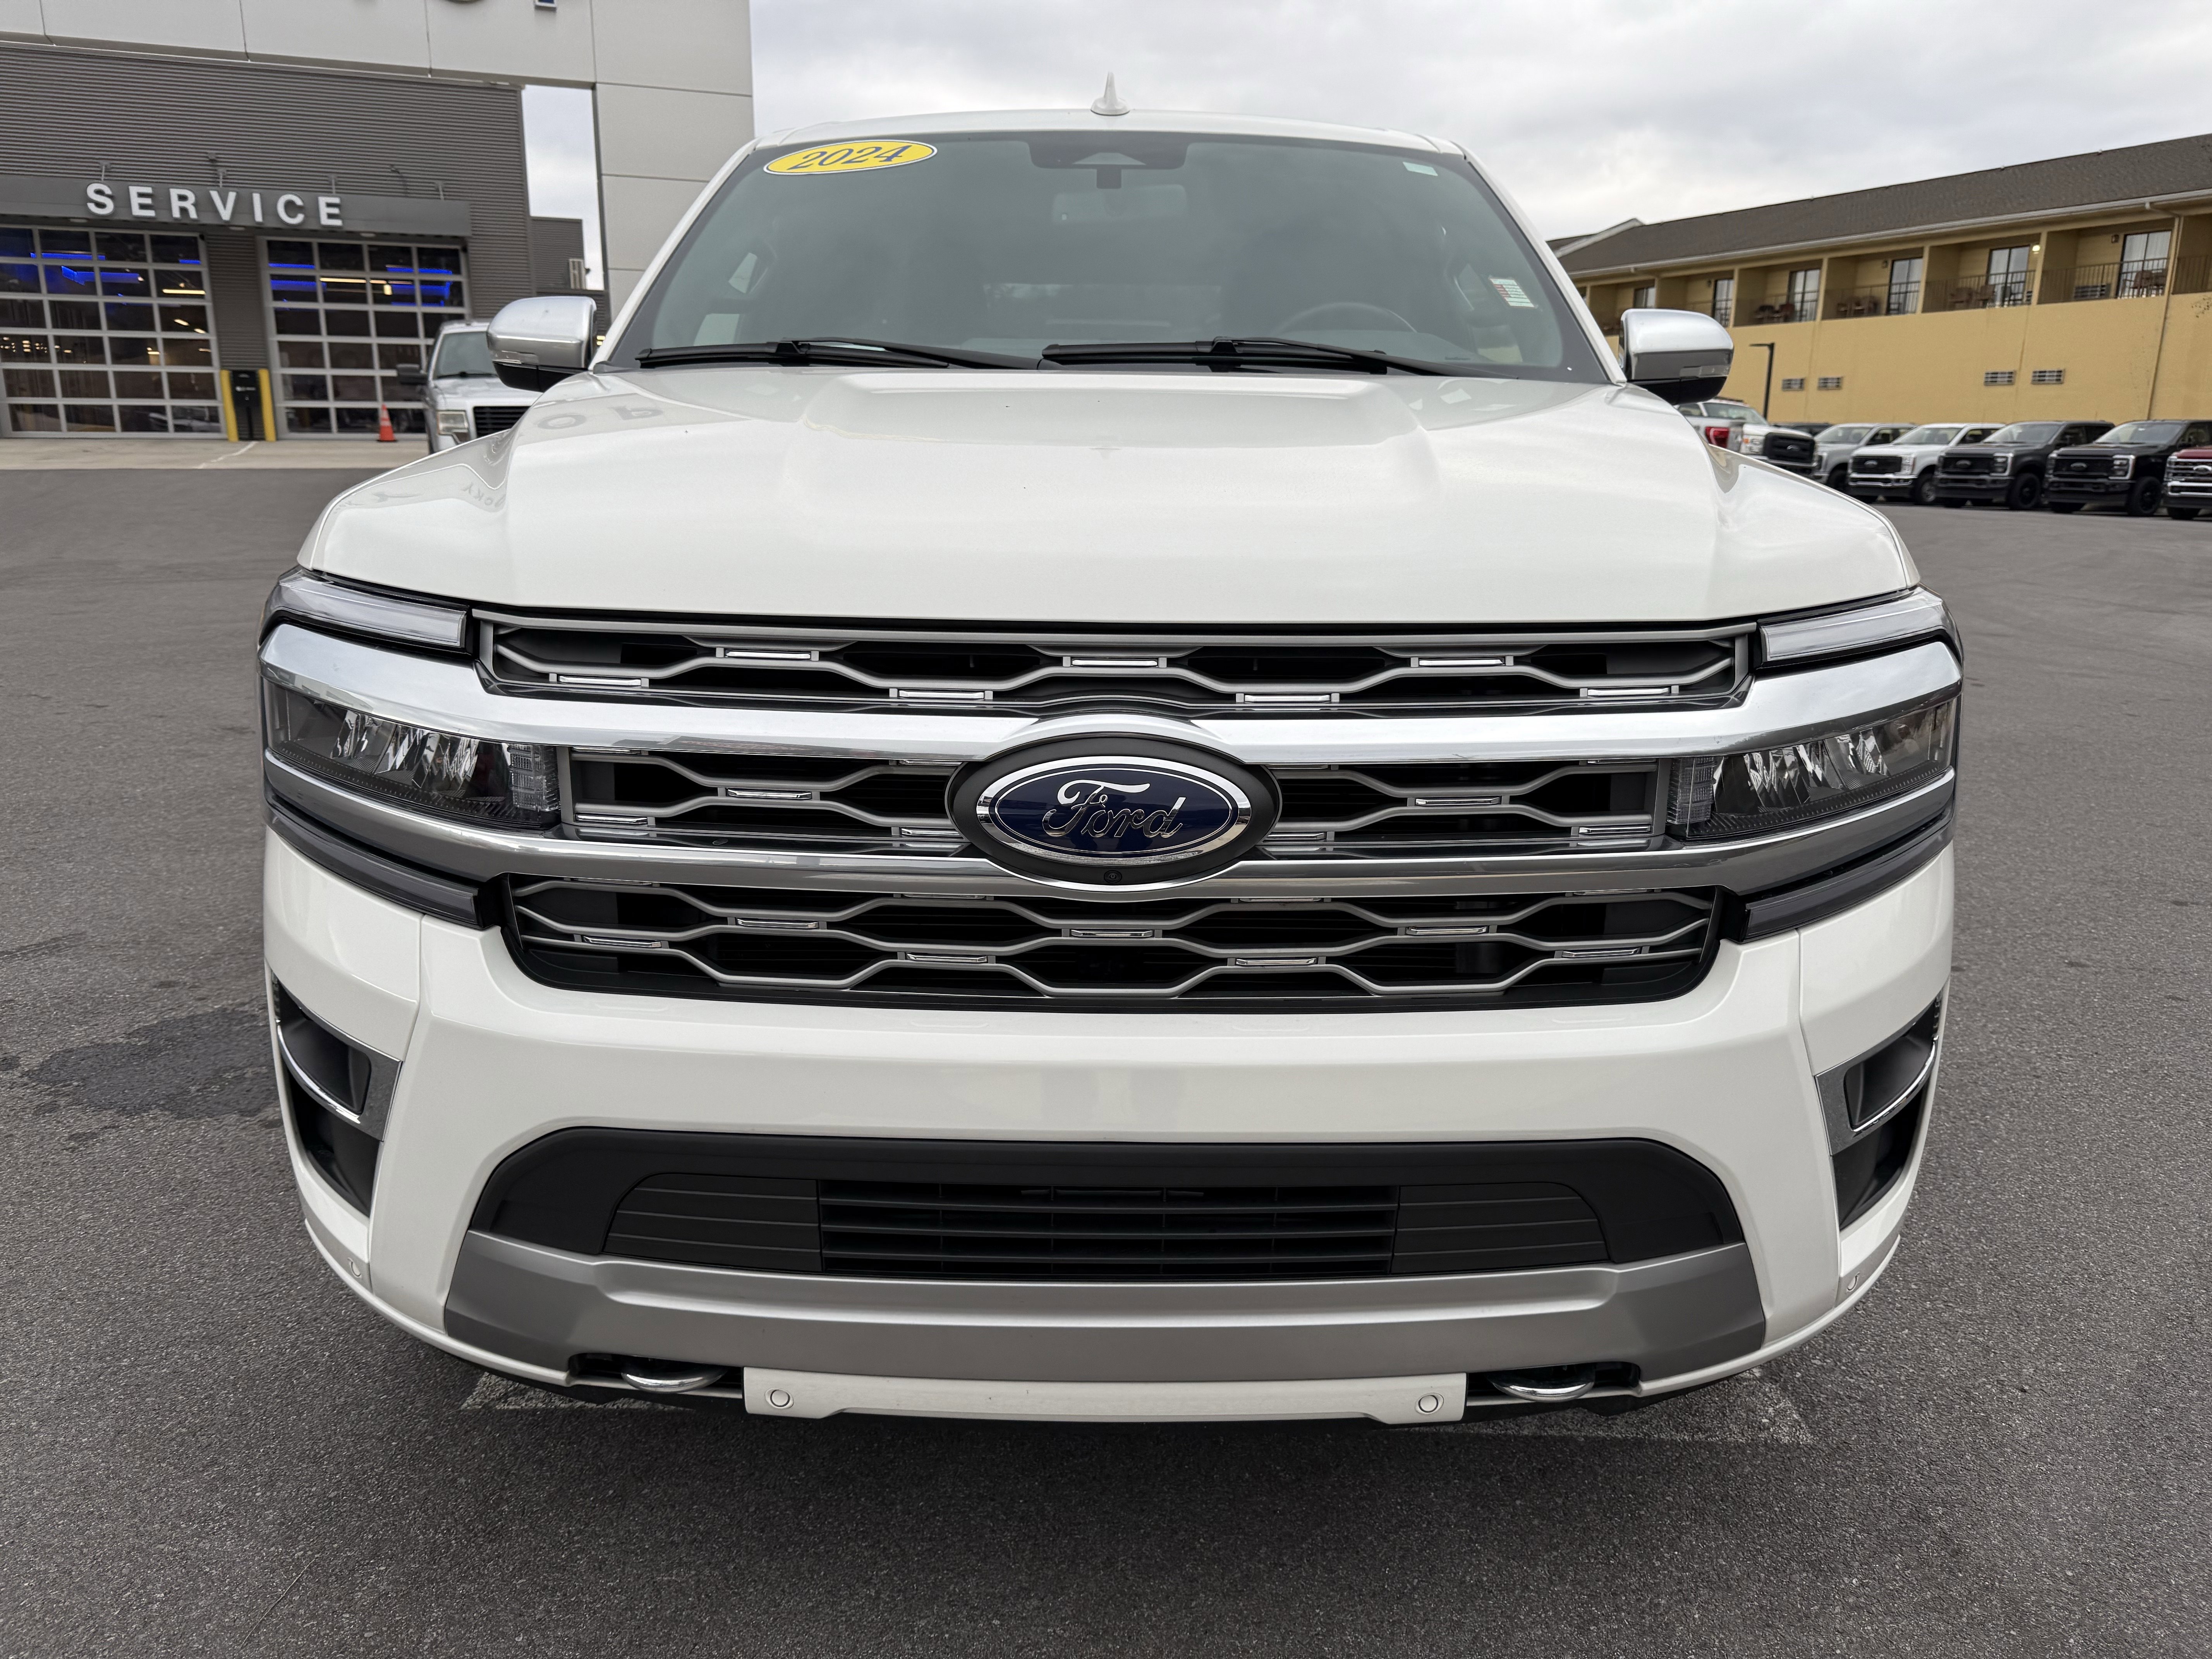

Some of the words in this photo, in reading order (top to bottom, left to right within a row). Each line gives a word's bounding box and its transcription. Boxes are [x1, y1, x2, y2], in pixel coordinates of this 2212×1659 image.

[787, 145, 911, 170] 2024
[86, 183, 343, 227] SERVICE
[1043, 779, 1186, 838] Ford
